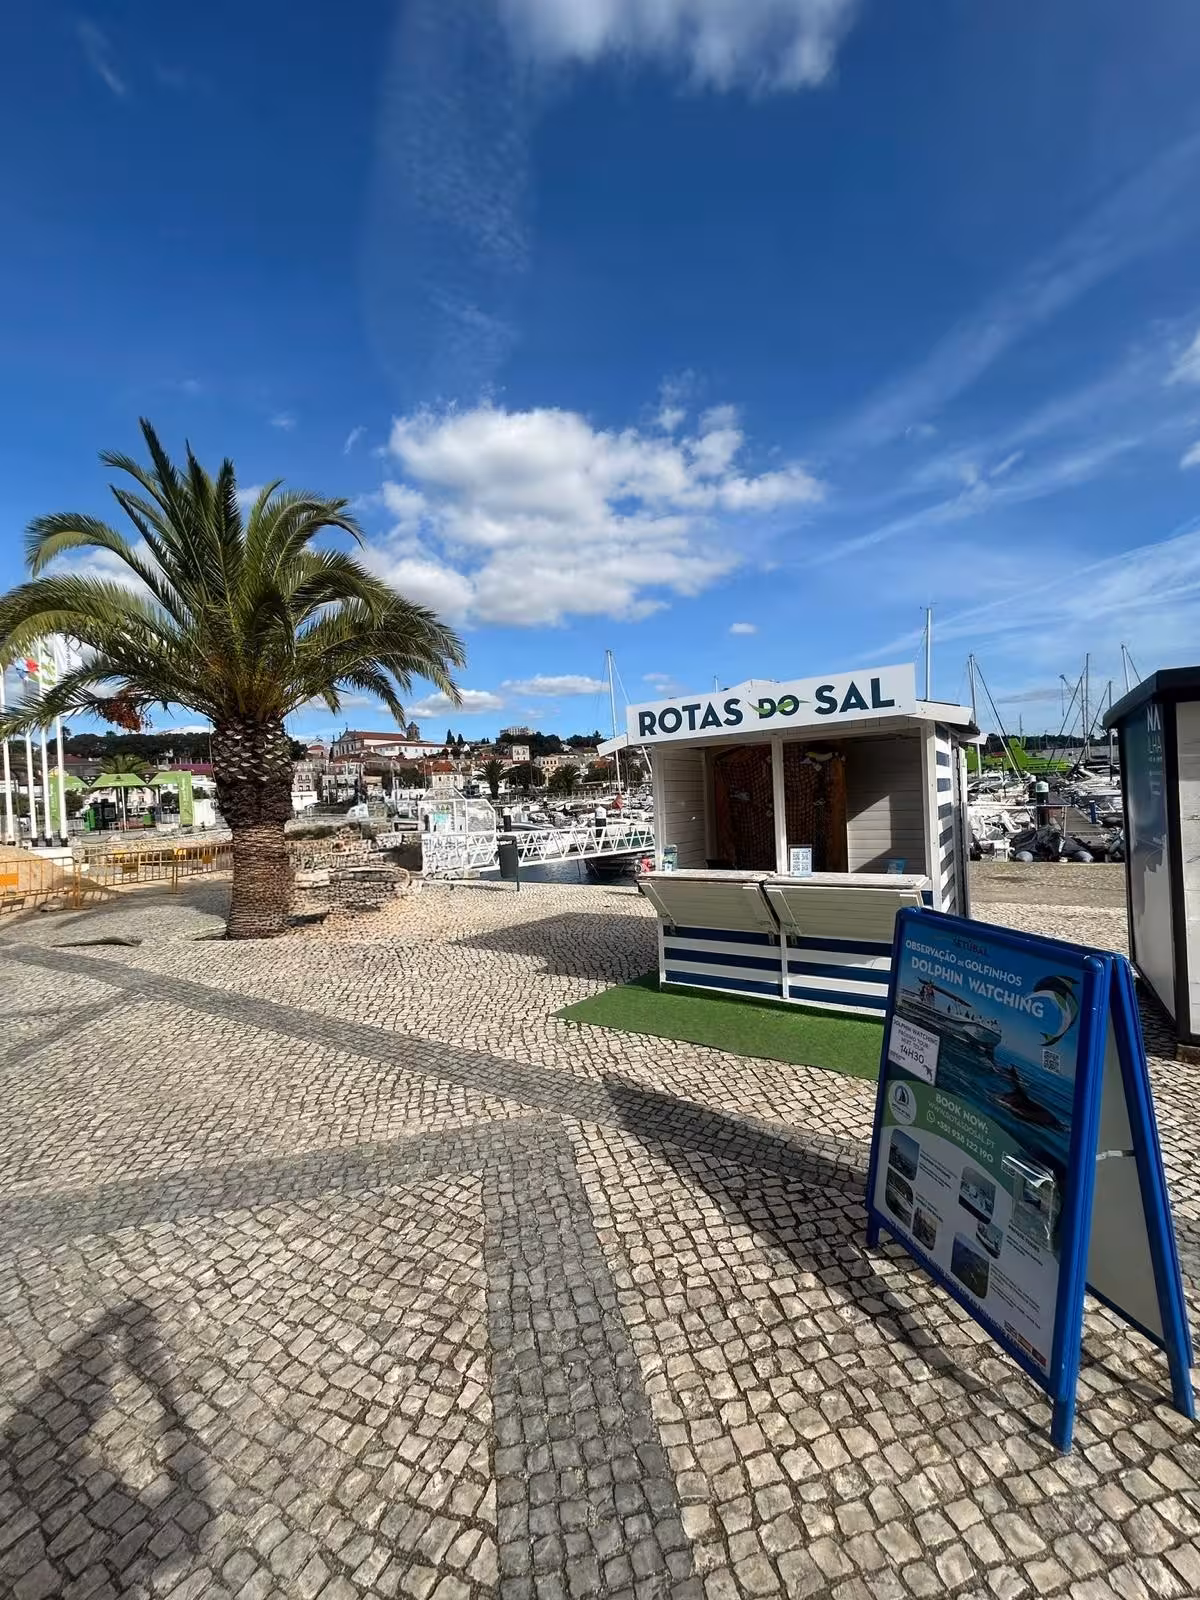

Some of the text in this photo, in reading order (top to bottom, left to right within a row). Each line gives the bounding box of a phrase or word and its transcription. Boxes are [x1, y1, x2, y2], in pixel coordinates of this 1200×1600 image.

[638, 677, 895, 737] ROTAS DO SAL
[905, 939, 957, 963] OBSERVAÇÃO
[964, 959, 1022, 987] GOLFINHOS
[911, 956, 1044, 1018] DOLPHIN WATCHING
[900, 1043, 924, 1065] 14H30
[935, 1093, 961, 1116] BOOK
[962, 1110, 989, 1134] NOW:
[966, 1137, 978, 1153] 122
[979, 1147, 993, 1163] 190
